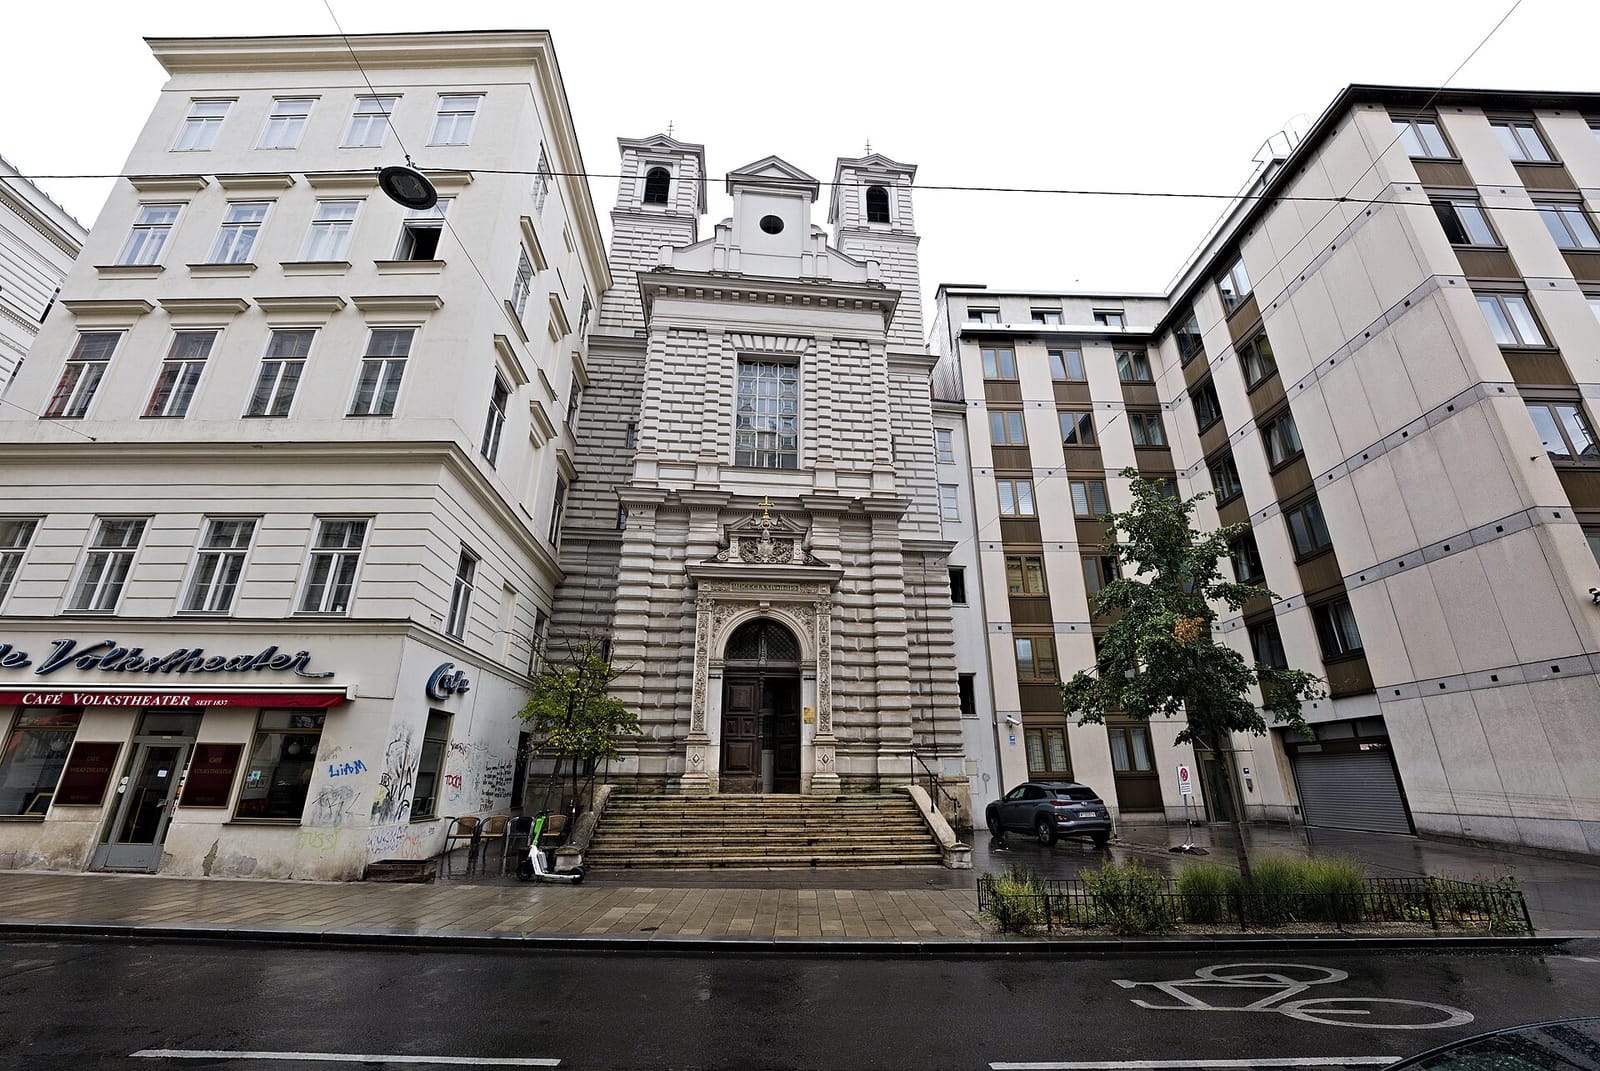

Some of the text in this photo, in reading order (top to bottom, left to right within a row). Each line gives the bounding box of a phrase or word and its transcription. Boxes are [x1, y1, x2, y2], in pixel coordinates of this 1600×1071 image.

[34, 639, 335, 678] Volkstheater
[22, 692, 63, 705] CAFÉ
[73, 693, 191, 706] VOLKSTHEATER
